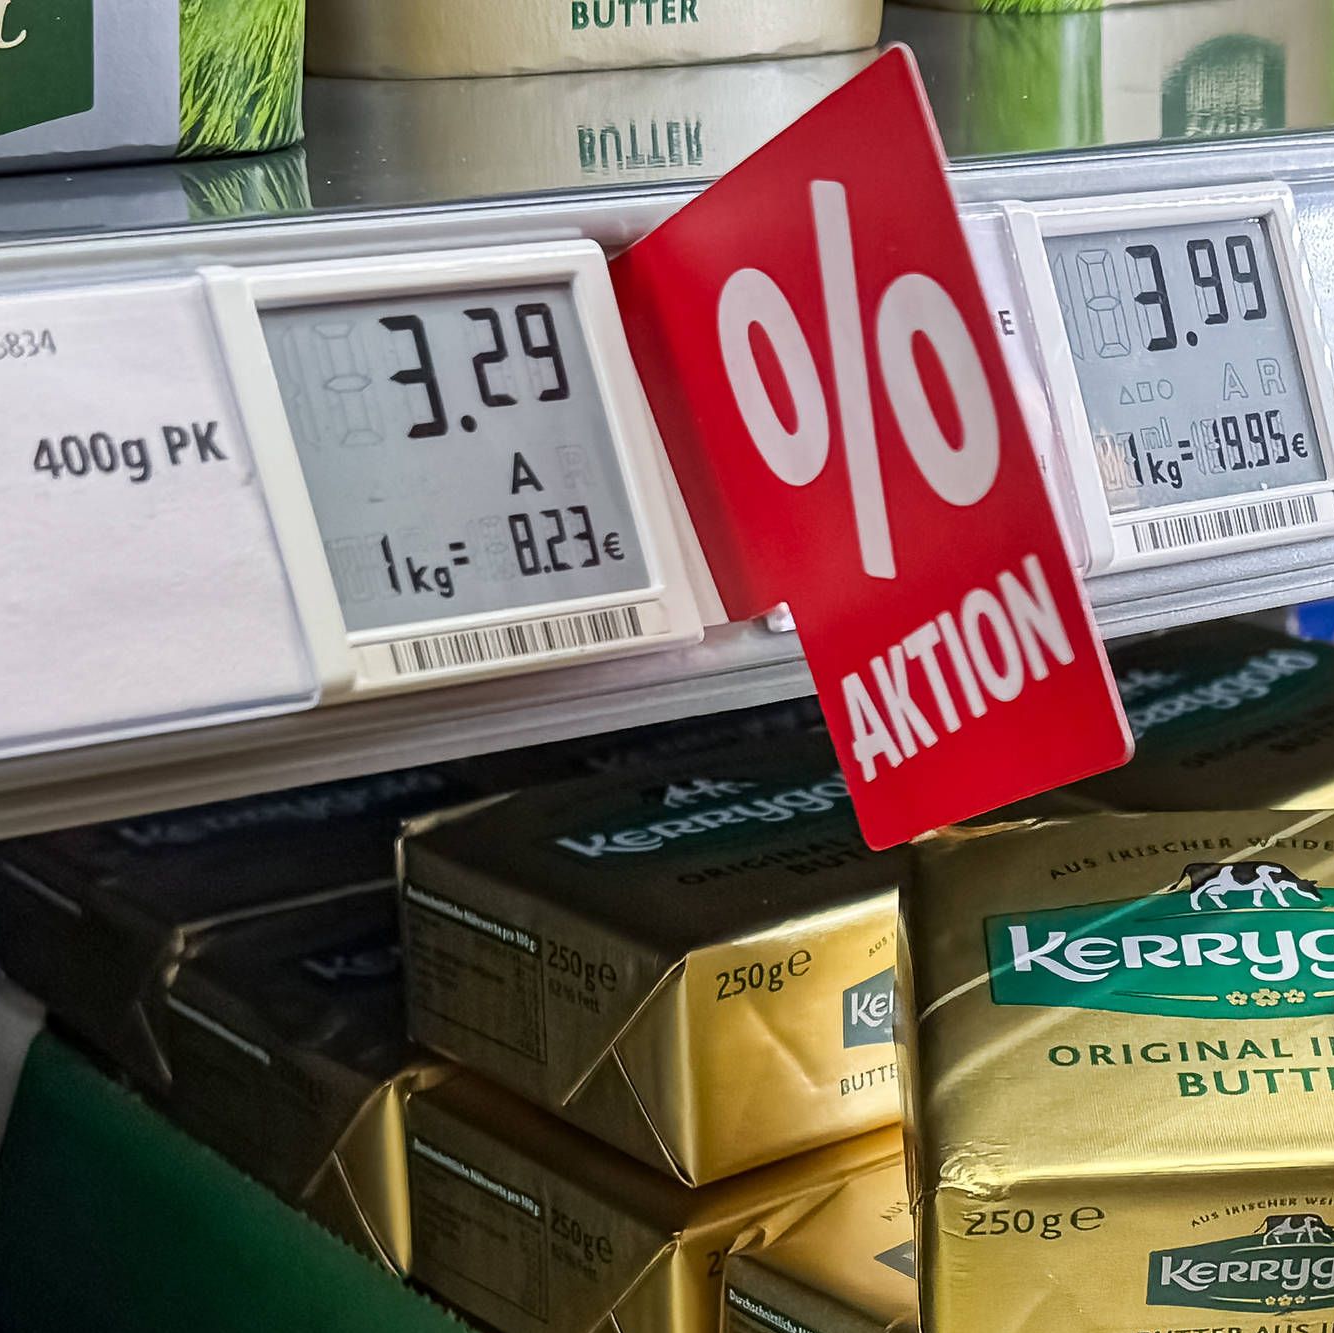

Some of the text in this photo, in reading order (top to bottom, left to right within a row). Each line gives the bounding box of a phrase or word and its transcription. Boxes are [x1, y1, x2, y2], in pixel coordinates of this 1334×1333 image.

[570, 0, 699, 30] BUTTER
[1126, 235, 1267, 351] 3.99
[379, 303, 569, 438] 3.29
[33, 420, 226, 485] 400g PK
[512, 452, 543, 494] A
[841, 555, 1075, 781] AKTION
[557, 773, 851, 858] Kerrygo
[1050, 857, 1097, 880] AUS
[1108, 837, 1232, 864] IRISCHER
[1048, 1037, 1293, 1068] ORIGINAL
[840, 1062, 898, 1096] BUTTE
[1190, 1211, 1219, 1227] AUS
[1225, 1196, 1298, 1216] IRISCHER
